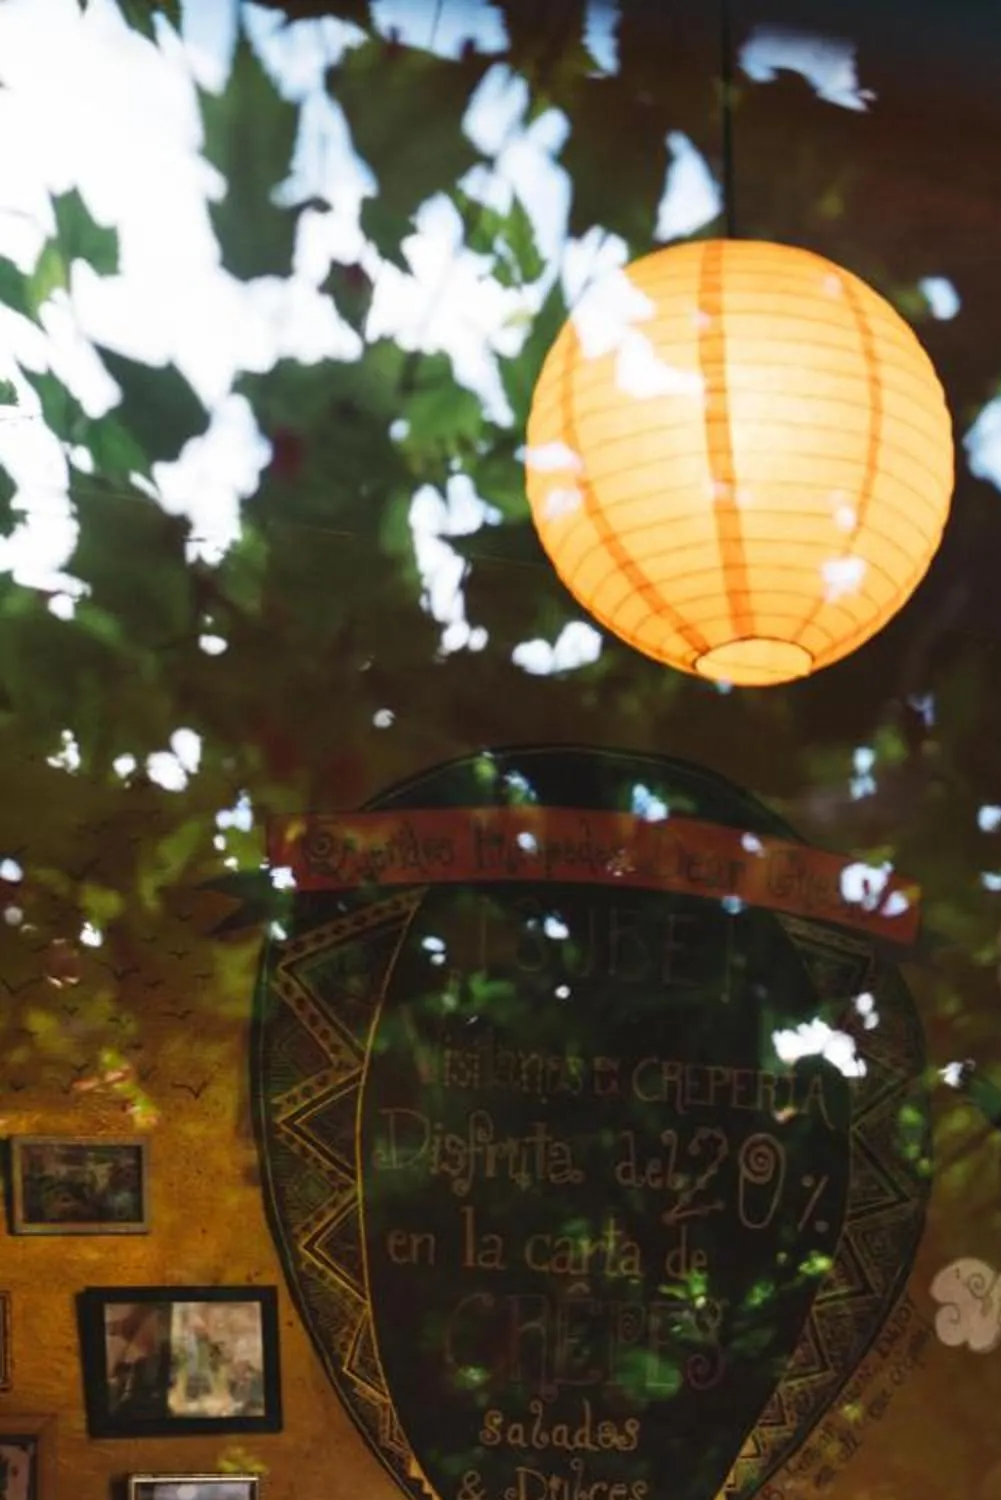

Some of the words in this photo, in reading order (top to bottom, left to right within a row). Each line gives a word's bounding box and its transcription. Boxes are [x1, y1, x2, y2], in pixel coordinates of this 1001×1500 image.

[661, 1125, 831, 1233] 20%
[386, 1227, 436, 1267] en
[460, 1205, 506, 1271] la
[524, 1213, 645, 1277] carta
[664, 1224, 710, 1281] de
